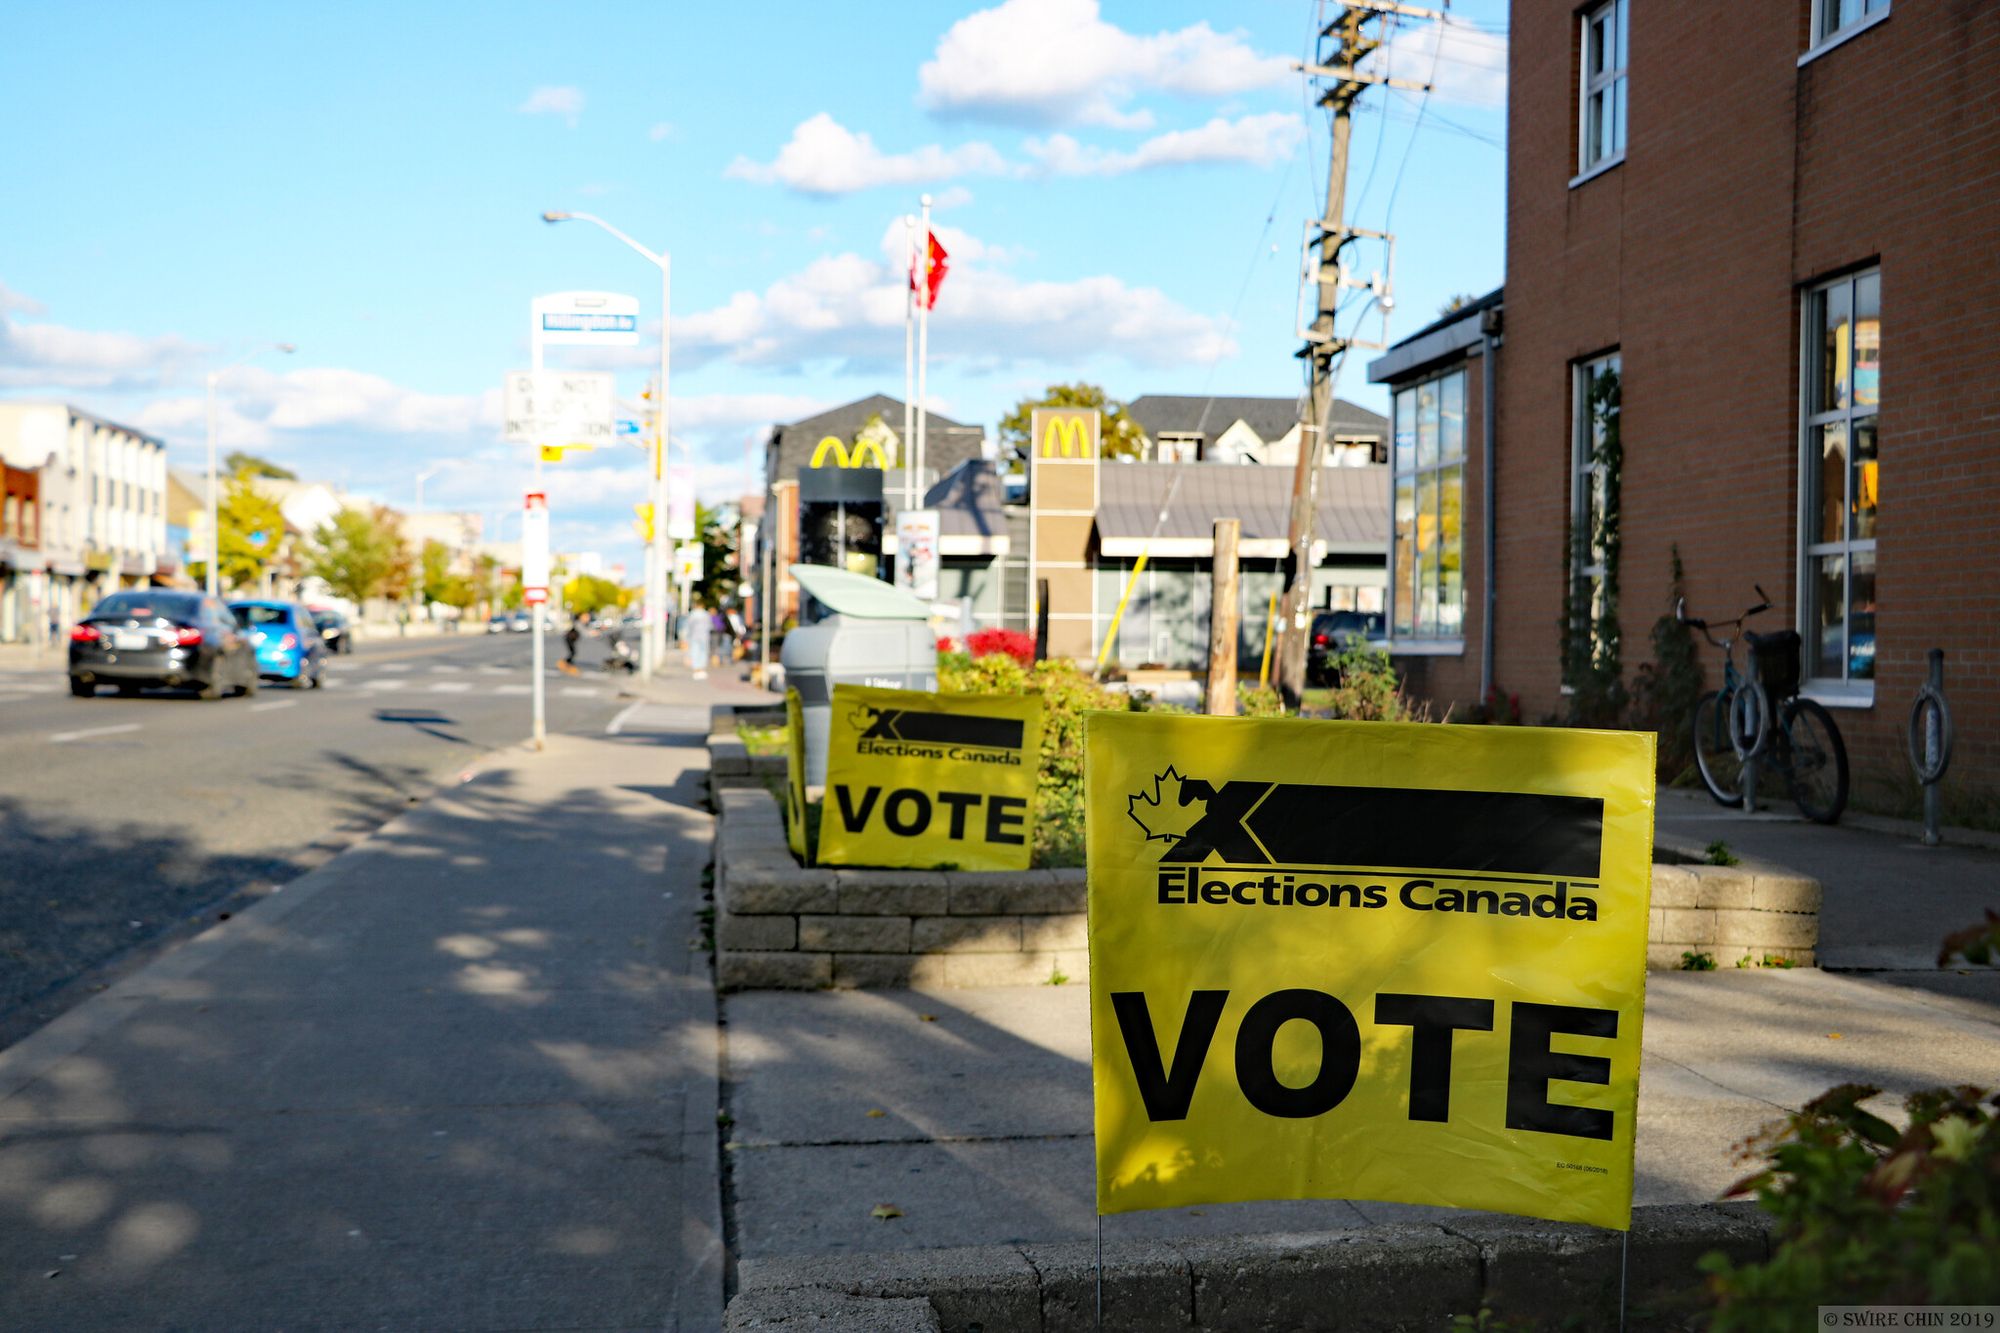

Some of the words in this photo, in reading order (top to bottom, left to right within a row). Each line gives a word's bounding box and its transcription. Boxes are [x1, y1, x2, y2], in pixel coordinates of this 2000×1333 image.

[857, 742, 943, 760] Elections
[948, 747, 1021, 766] Canada
[834, 784, 1027, 846] VOTE
[1157, 866, 1388, 909] Elections
[1399, 880, 1599, 922] Canada
[1110, 988, 1619, 1142] VOTE
